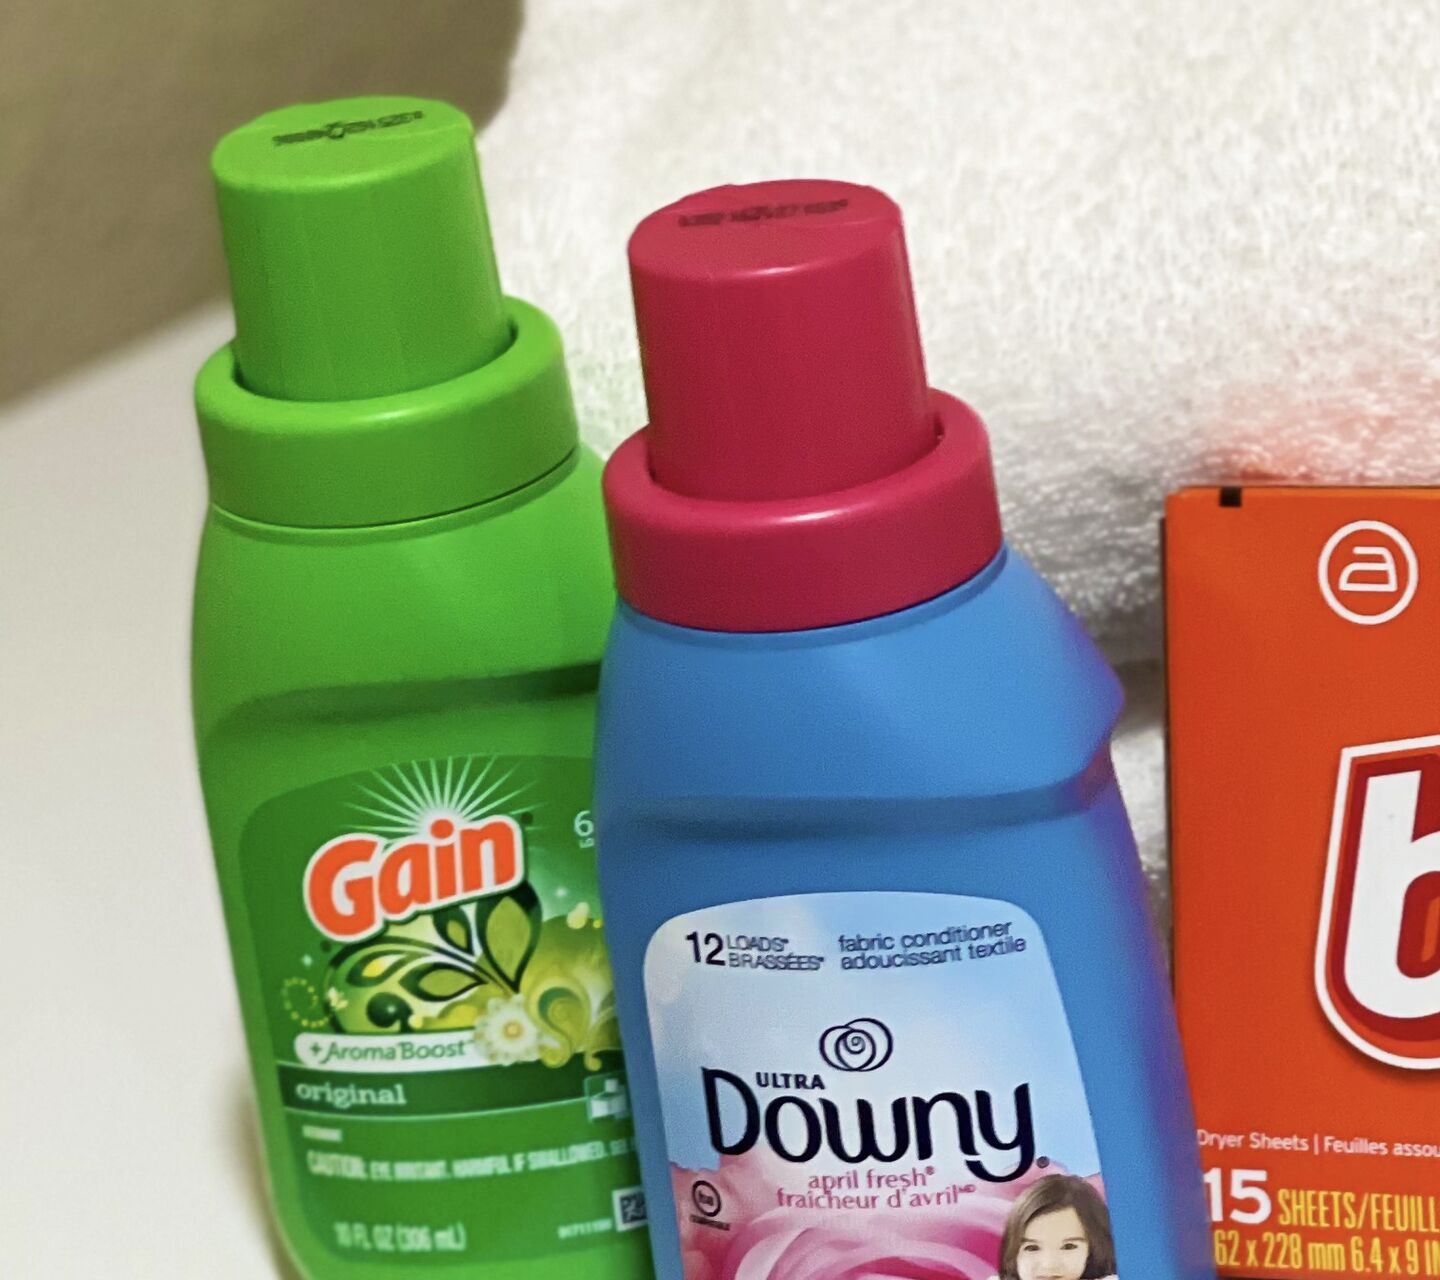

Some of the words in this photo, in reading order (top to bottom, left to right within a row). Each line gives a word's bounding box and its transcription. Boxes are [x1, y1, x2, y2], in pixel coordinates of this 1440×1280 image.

[306, 816, 517, 939] Gain
[686, 931, 726, 967] 12
[838, 933, 895, 952] fabric
[900, 921, 1012, 949] conditioner
[840, 945, 962, 970] adoucissant
[968, 936, 1027, 960] textile
[296, 1082, 407, 1109] original
[755, 1071, 826, 1090] ULTRA
[700, 1066, 1036, 1183] Downy
[1196, 1128, 1245, 1151] Dryer
[1249, 1131, 1310, 1152] Sheets
[1323, 1136, 1388, 1156] Feuilles
[808, 1169, 859, 1194] april
[1202, 1167, 1272, 1224] 15
[1246, 1239, 1258, 1267] x
[1262, 1231, 1303, 1270] 228
[1307, 1242, 1346, 1272] mm
[1350, 1235, 1383, 1273] 6.4
[1387, 1246, 1402, 1274] x
[1404, 1238, 1419, 1275] 9
